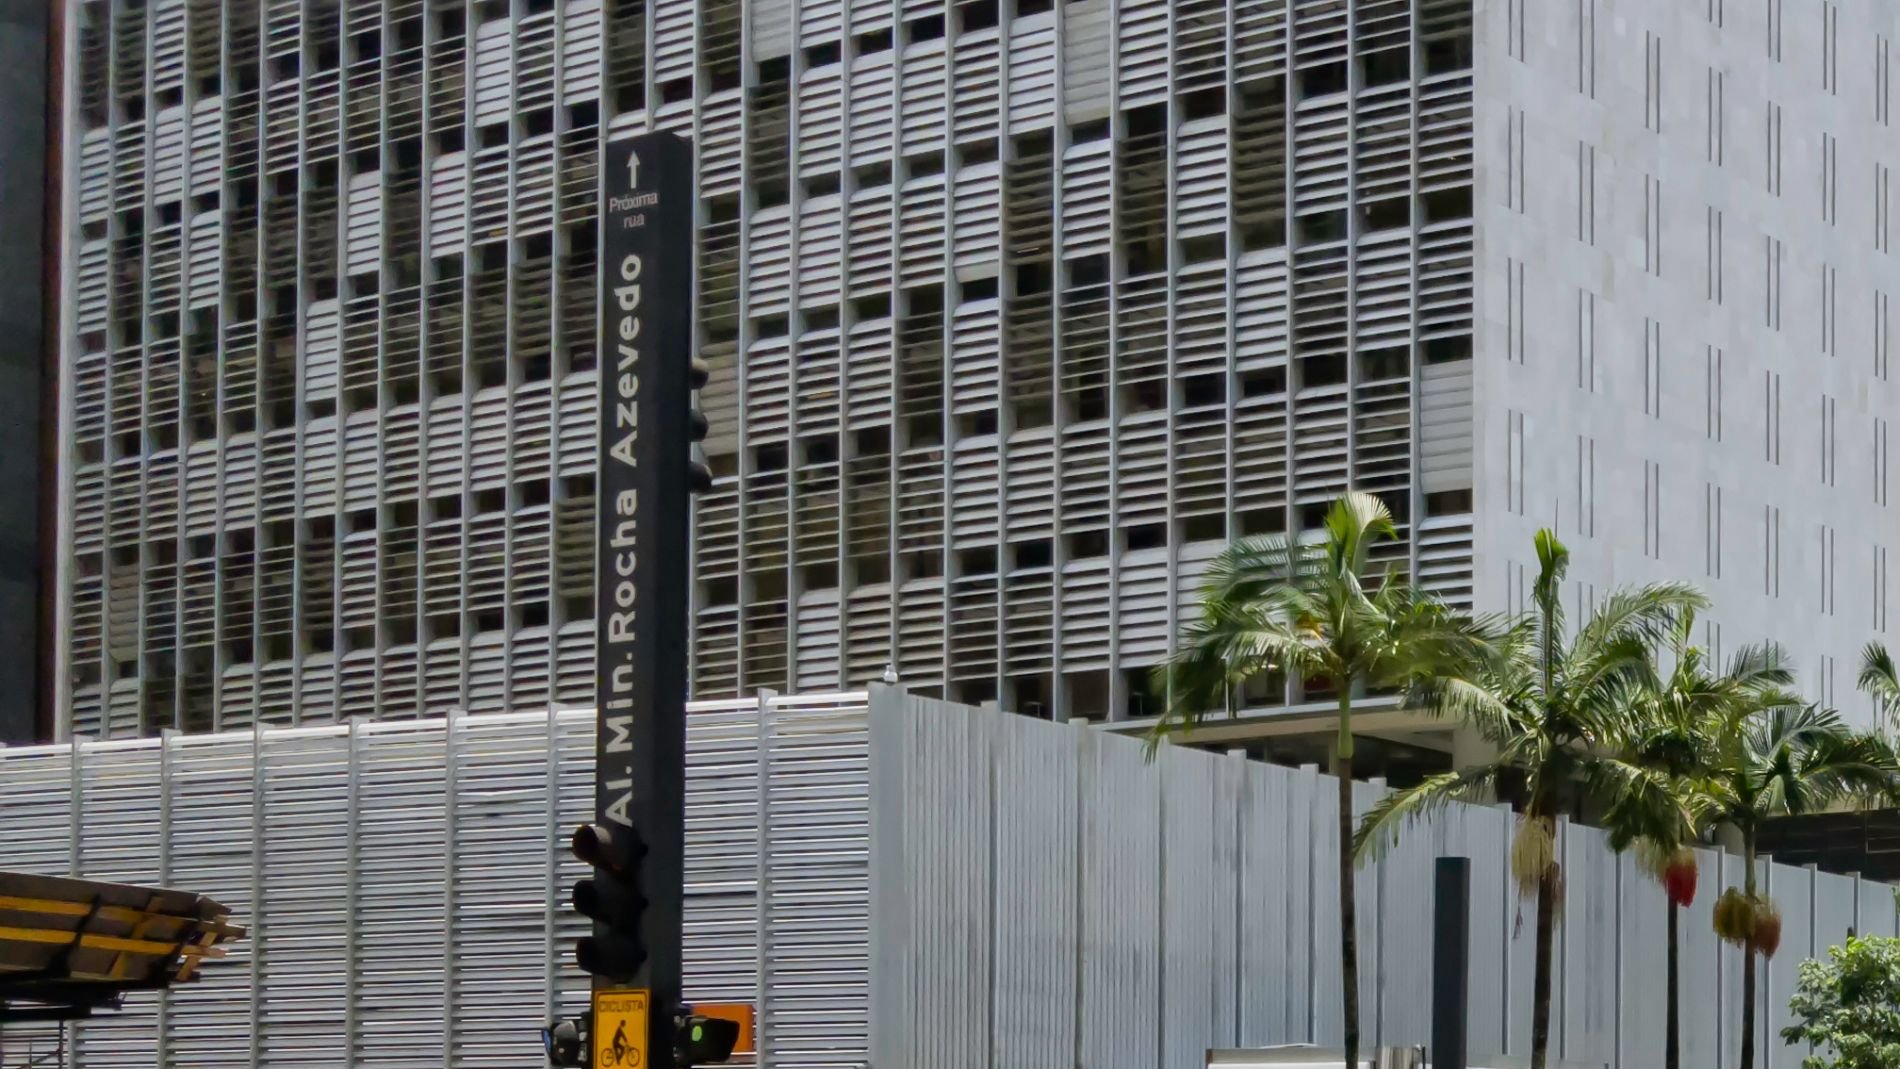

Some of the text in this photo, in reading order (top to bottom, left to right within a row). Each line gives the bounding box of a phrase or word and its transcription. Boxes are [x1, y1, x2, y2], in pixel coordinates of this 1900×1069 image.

[609, 192, 658, 213] Próxima
[624, 213, 645, 229] rua
[605, 254, 641, 826] Al. Min. Rocha Azevedo
[599, 999, 644, 1013] CICLISTA
